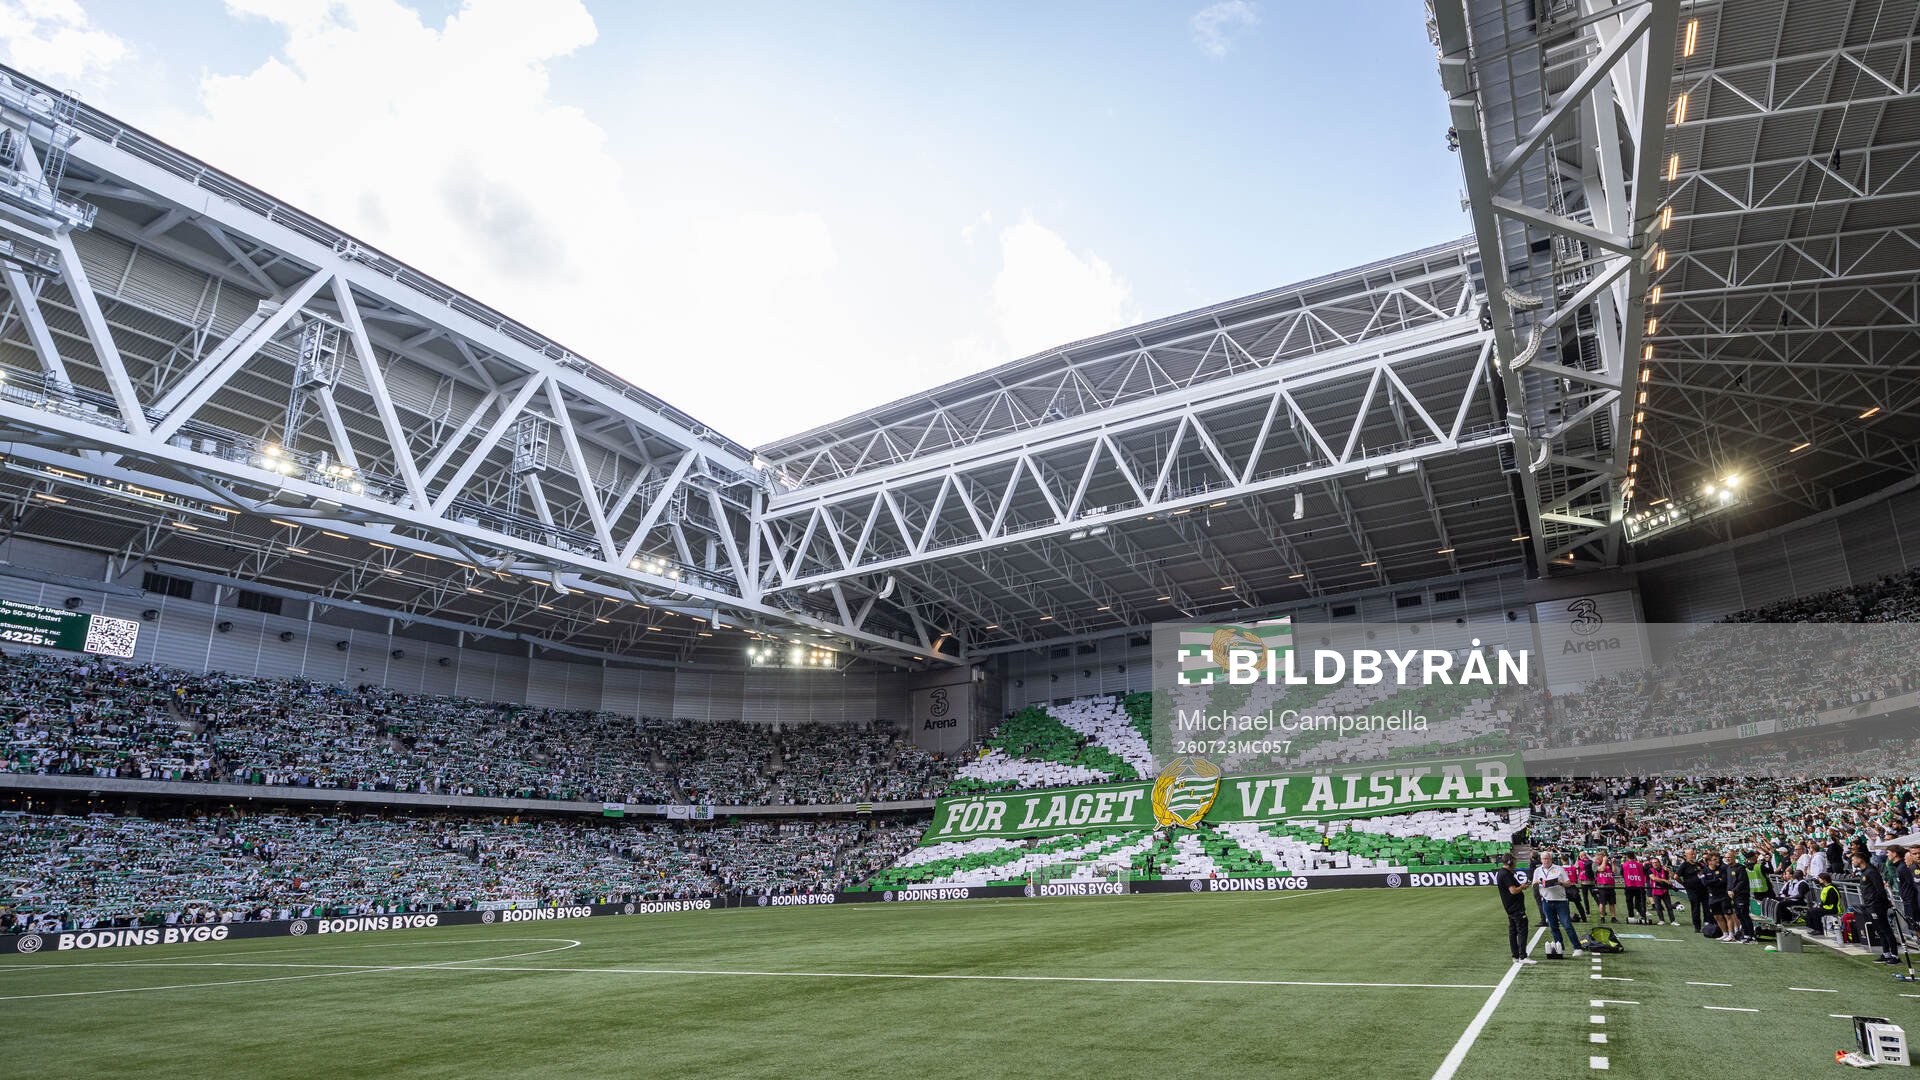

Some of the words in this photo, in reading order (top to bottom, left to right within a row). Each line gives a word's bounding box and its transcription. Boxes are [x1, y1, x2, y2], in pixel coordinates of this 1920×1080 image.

[2, 600, 45, 612] Hammarby
[45, 606, 77, 617] Ungdom
[12, 610, 36, 618] 50-50
[0, 630, 43, 645] 4225
[44, 637, 57, 646] kr
[33, 626, 49, 634] just
[1562, 637, 1621, 655] Arena
[923, 718, 957, 731] Arena
[1236, 778, 1290, 817] VI
[1302, 760, 1513, 812] ÄLSKAR
[939, 796, 1007, 835] FÖR
[1017, 789, 1145, 831] LAGET
[1209, 877, 1265, 892] BODINS
[1267, 876, 1308, 890] BYGG
[1410, 871, 1476, 887] BODINS
[1478, 870, 1528, 886] BYG
[898, 889, 939, 902] BODINS
[940, 887, 969, 900] BYGG
[1040, 883, 1087, 896] BODINS
[1088, 882, 1123, 895] BYGG
[640, 901, 682, 914] BODINS
[683, 899, 712, 912] BYGG
[771, 894, 808, 906] BODINS
[808, 893, 835, 905] BYGG
[502, 908, 555, 923] BODINS
[556, 906, 592, 919] BYGG
[317, 916, 389, 934] BODINS
[392, 914, 439, 929] BYGG
[57, 928, 160, 950] BODINS
[163, 924, 229, 944] BYGG
